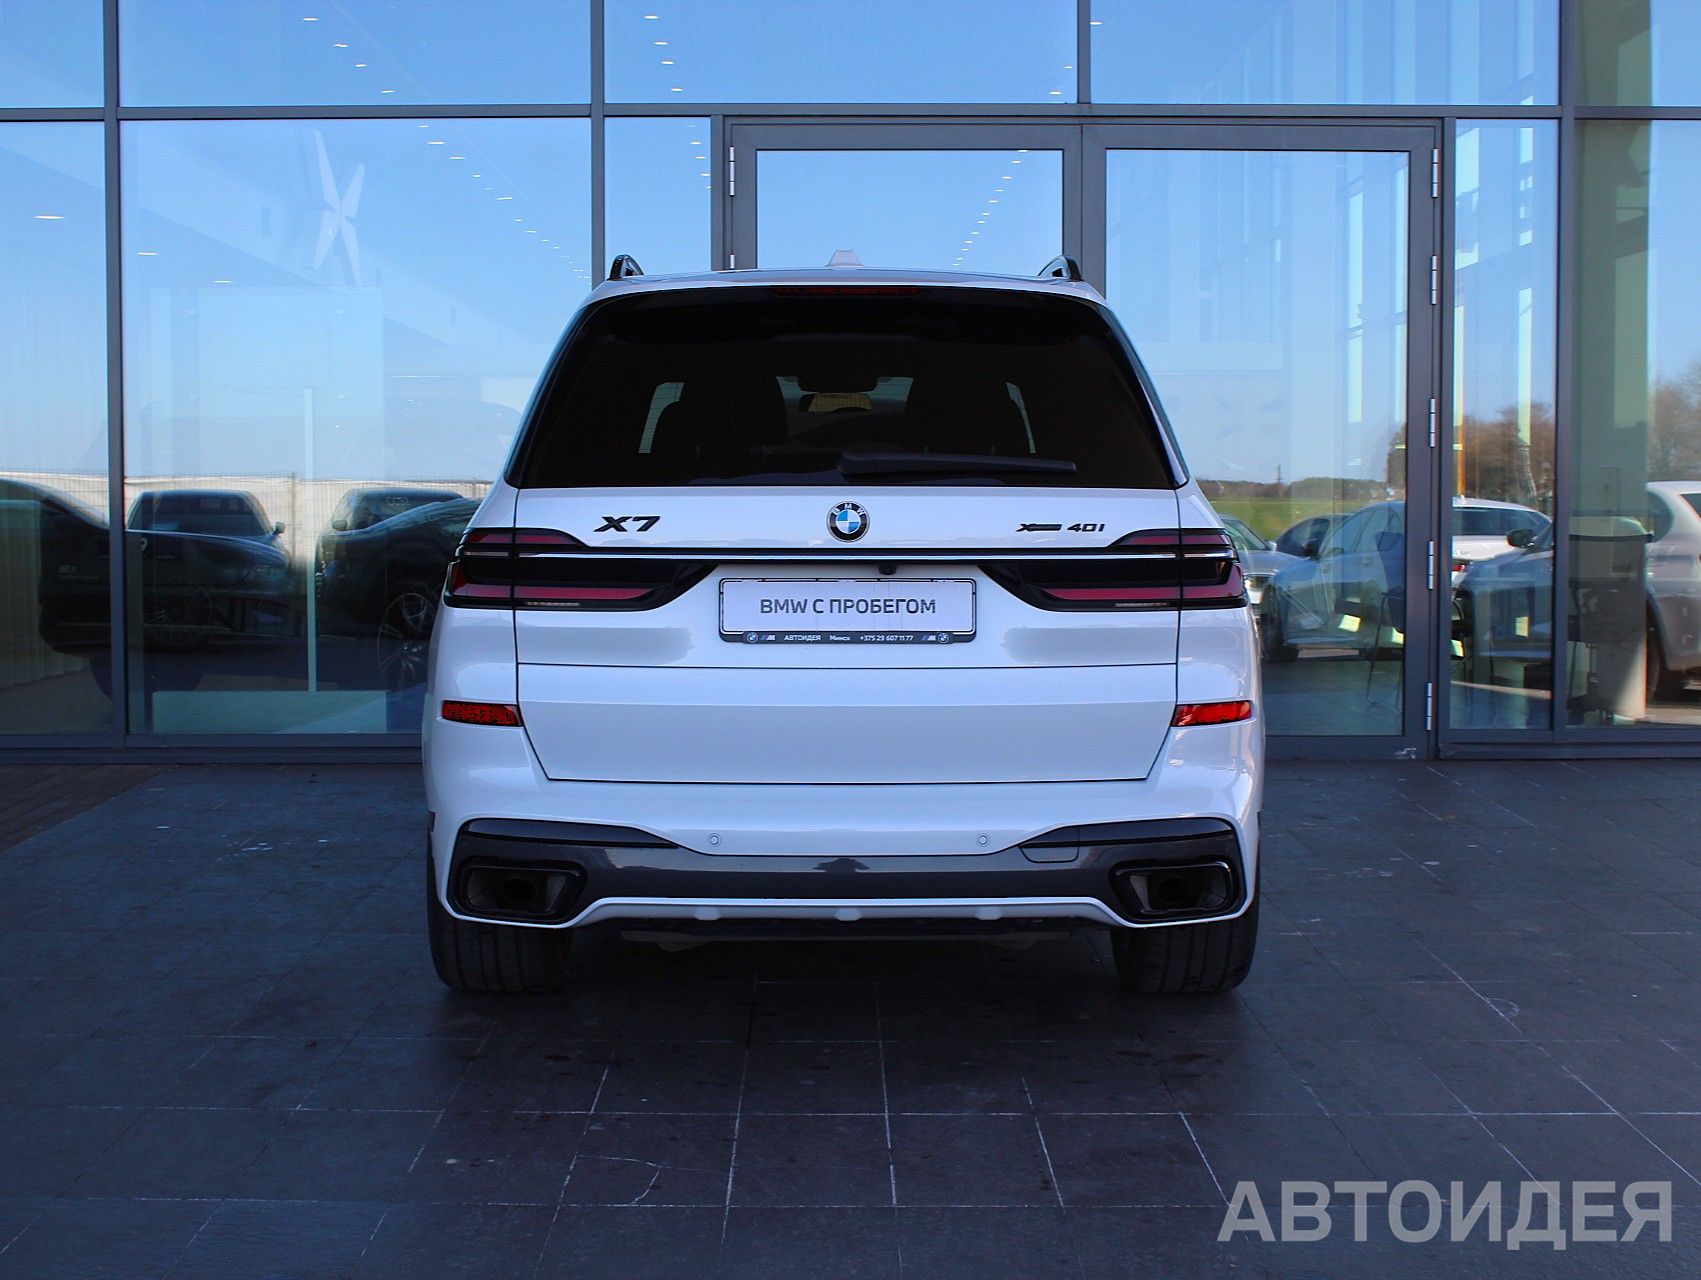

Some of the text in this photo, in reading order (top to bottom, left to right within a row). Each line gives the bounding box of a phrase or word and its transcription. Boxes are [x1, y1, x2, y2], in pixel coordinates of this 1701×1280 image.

[593, 516, 661, 533] X7
[760, 599, 936, 614] BMW С ПРОБЕГОМ
[783, 634, 822, 642] АВТОИДЕЯ
